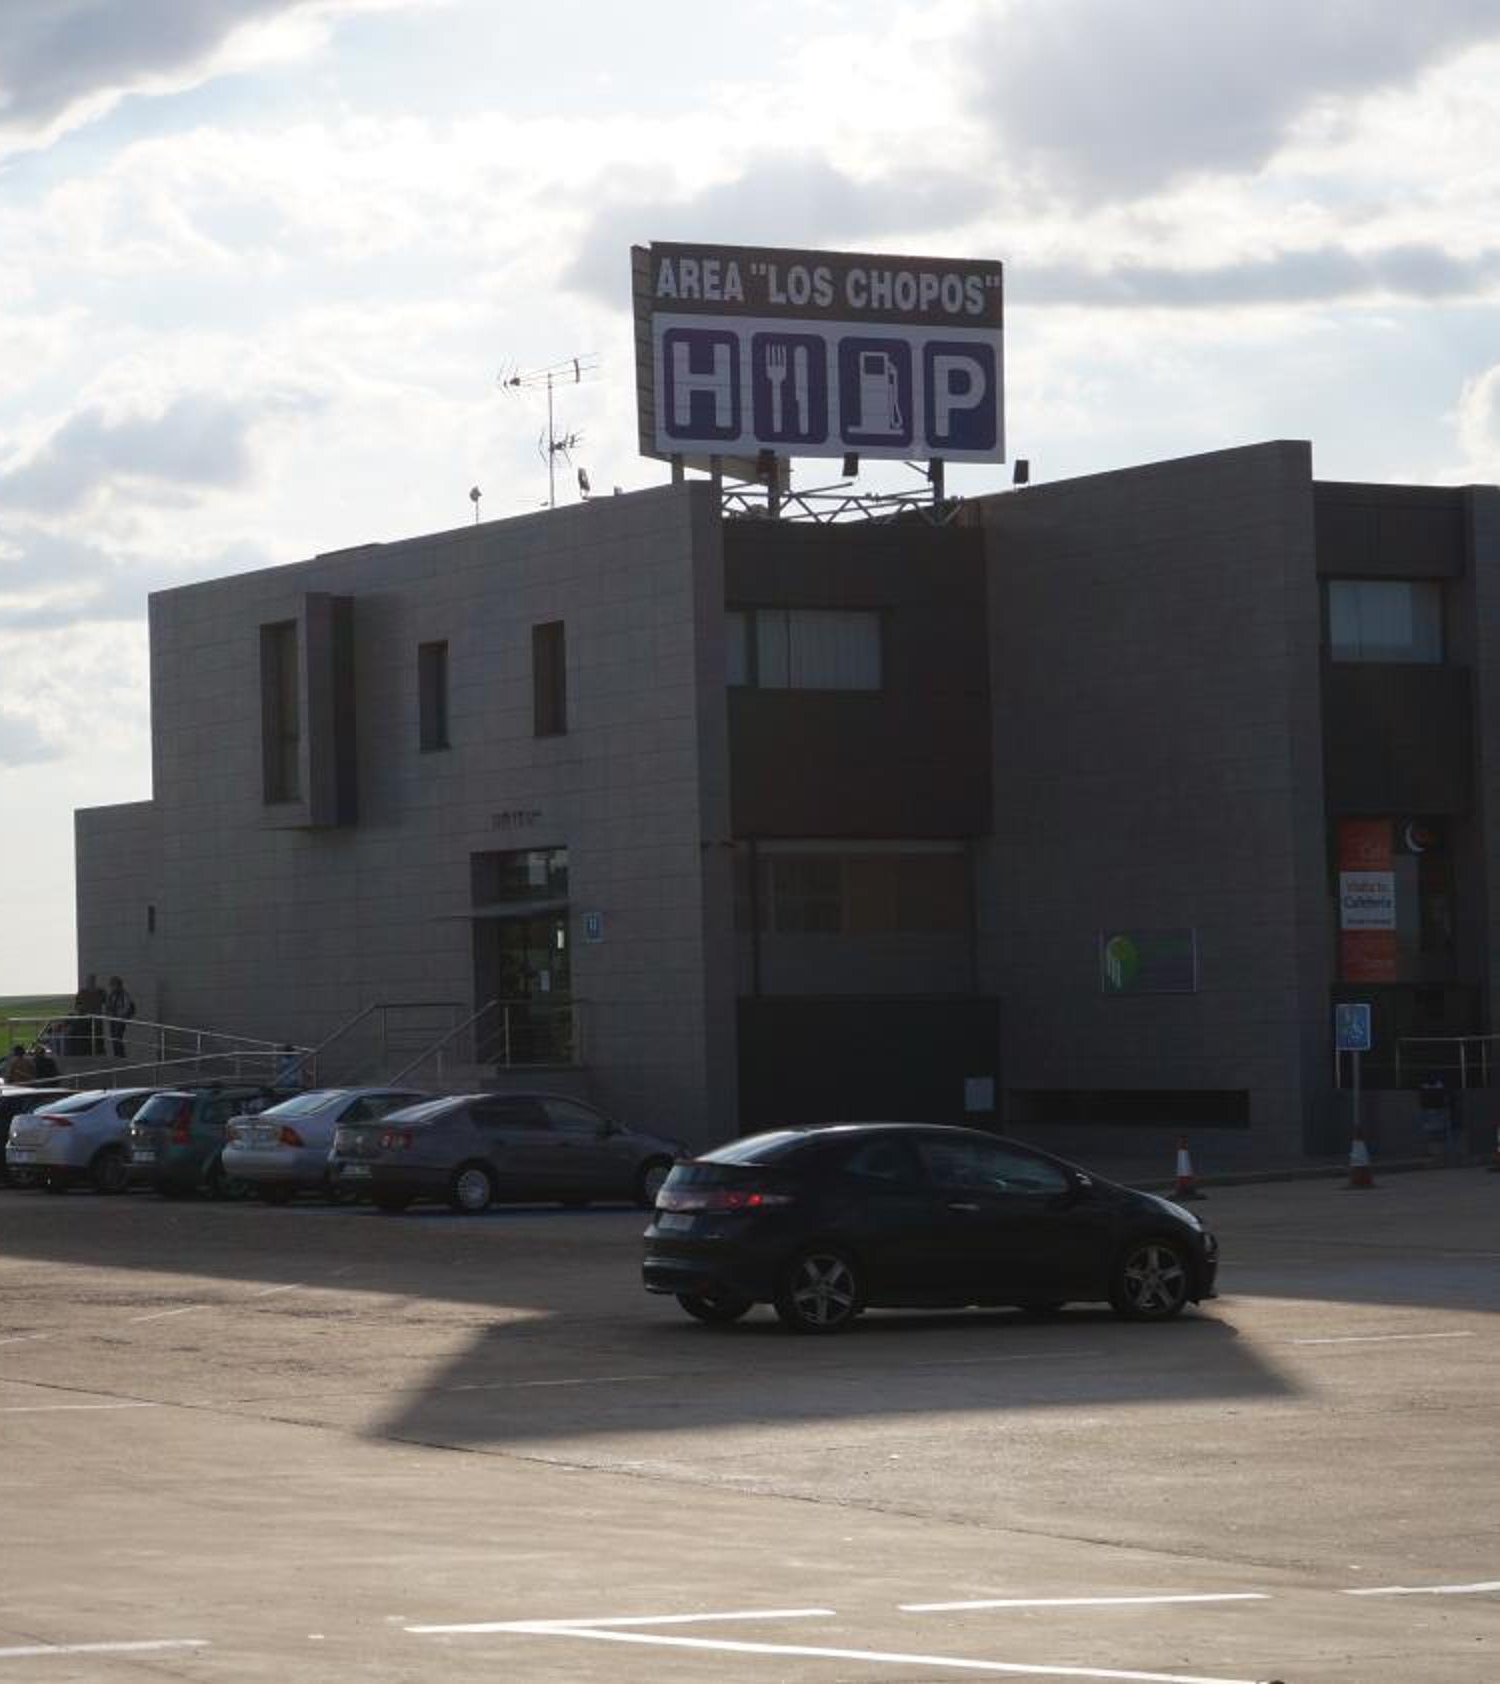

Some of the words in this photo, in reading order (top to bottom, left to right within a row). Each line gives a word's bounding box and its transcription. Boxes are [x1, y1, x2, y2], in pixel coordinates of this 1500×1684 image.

[655, 256, 745, 302] AREA
[750, 261, 838, 307] "LOS
[845, 267, 1002, 316] CHOPOS"
[672, 340, 734, 429] H
[933, 354, 987, 438] P
